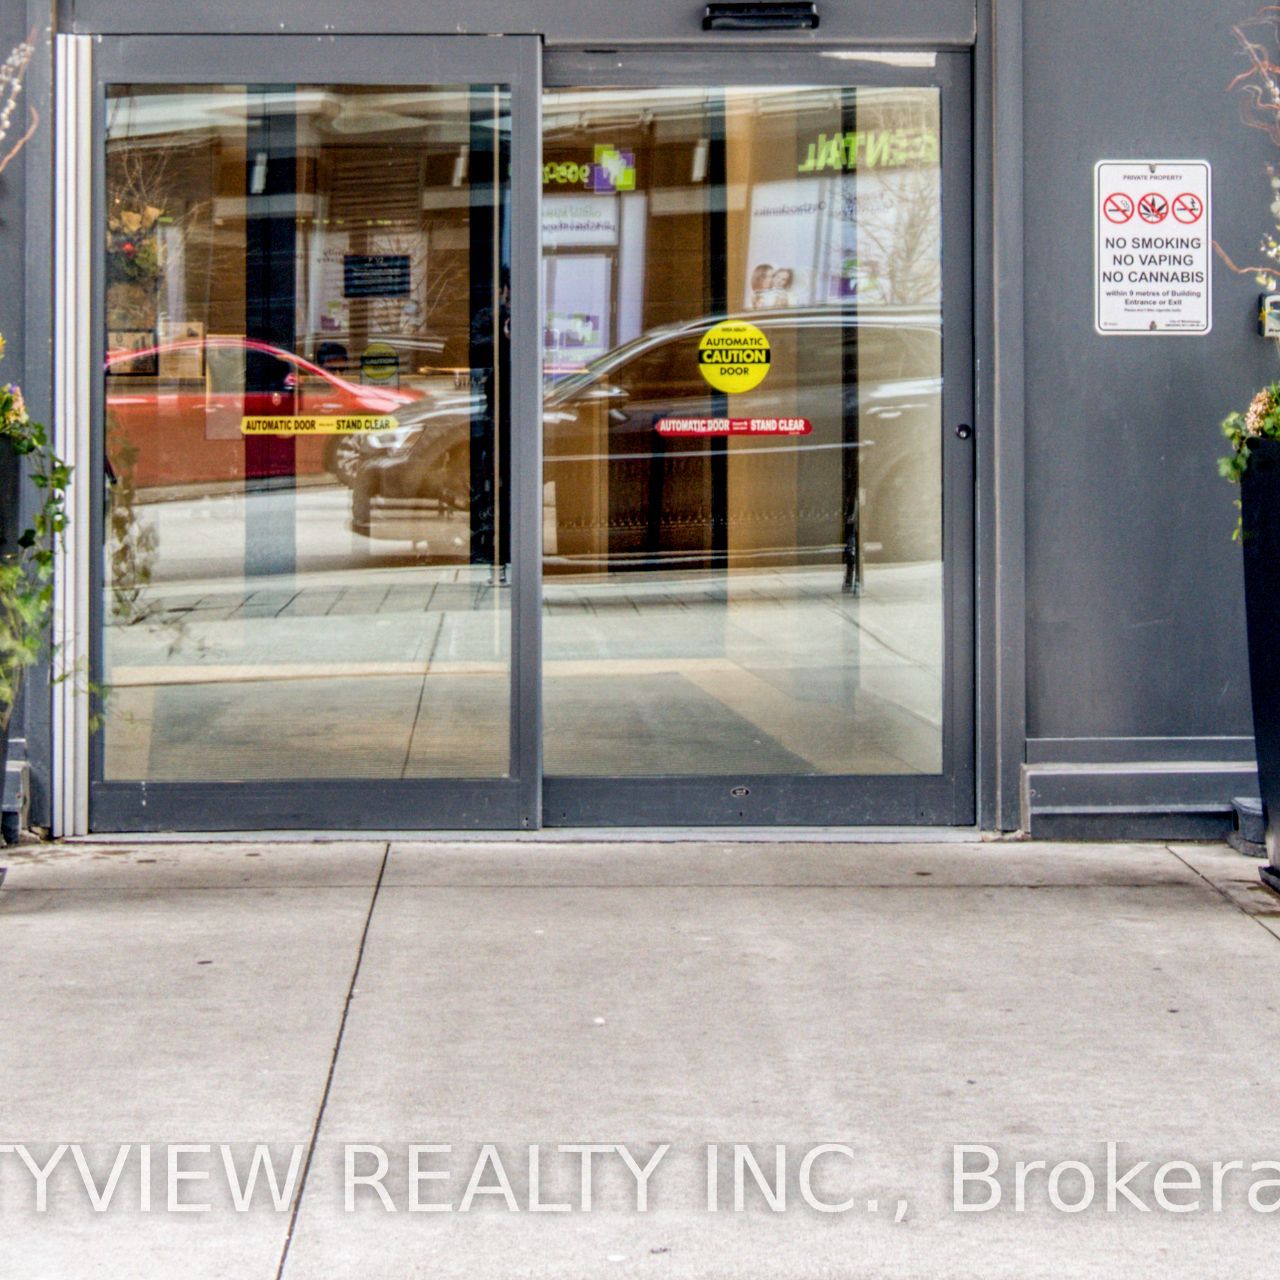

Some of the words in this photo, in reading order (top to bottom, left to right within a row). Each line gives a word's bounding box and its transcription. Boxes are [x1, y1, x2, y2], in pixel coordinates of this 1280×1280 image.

[1105, 237, 1127, 249] NO
[1131, 237, 1201, 249] SMOKING
[1112, 254, 1135, 266] NO
[1139, 254, 1194, 266] VAPING
[1102, 271, 1124, 283] NO
[1128, 271, 1205, 283] CANNABIS
[1106, 289, 1128, 297] within
[1129, 289, 1134, 297] 9
[1161, 289, 1170, 297] of
[1171, 289, 1202, 298] Building
[1124, 298, 1157, 306] Entrance
[1168, 298, 1183, 306] Exit
[706, 337, 764, 347] AUTOMATIC
[702, 349, 767, 363] CAUTION
[720, 367, 750, 376] DOOR
[246, 419, 292, 431] AUTOMATIC
[293, 419, 316, 431] DOOR
[335, 419, 362, 430] STAND
[364, 419, 390, 430] CLEAR
[660, 419, 707, 432] AUTOMATIC
[707, 419, 730, 431] DOOR
[750, 419, 777, 431] STAND
[778, 419, 805, 431] CLEAR
